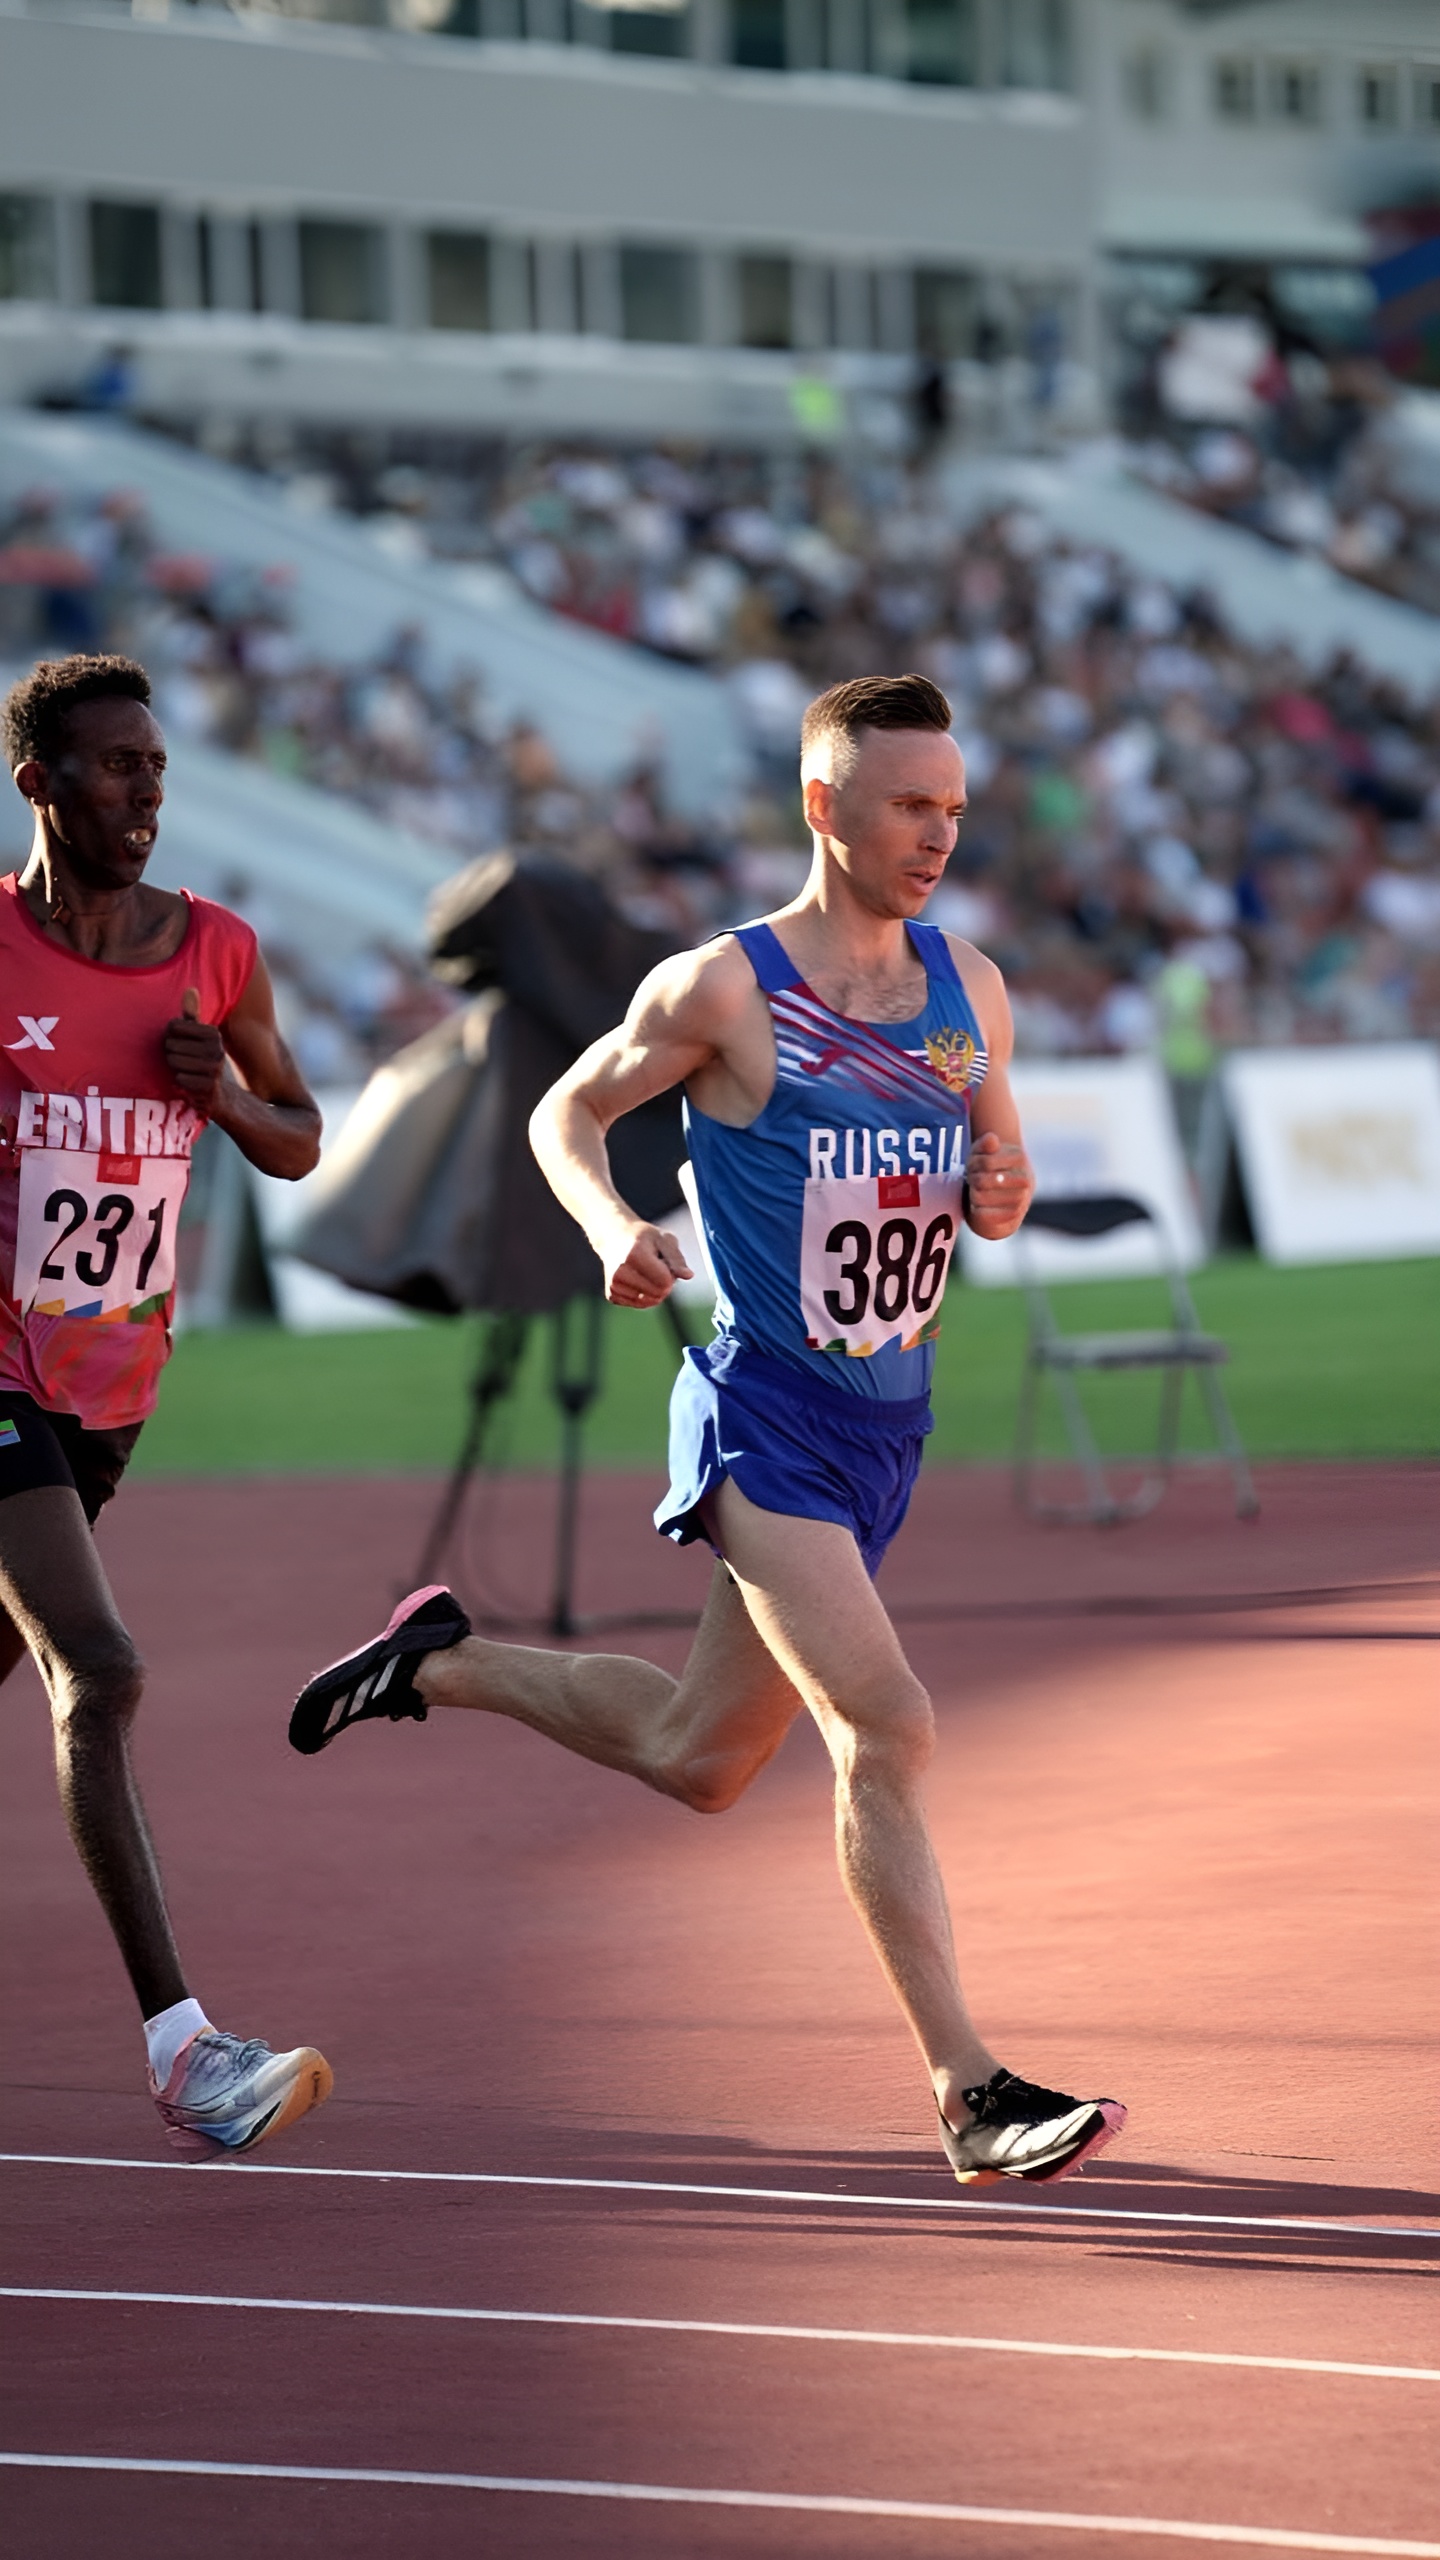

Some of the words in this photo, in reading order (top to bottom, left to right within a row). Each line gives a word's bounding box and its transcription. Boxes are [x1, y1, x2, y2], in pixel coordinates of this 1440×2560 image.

[809, 1125, 964, 1180] RUSSIA
[40, 1189, 165, 1290] 231
[823, 1213, 953, 1325] 386
